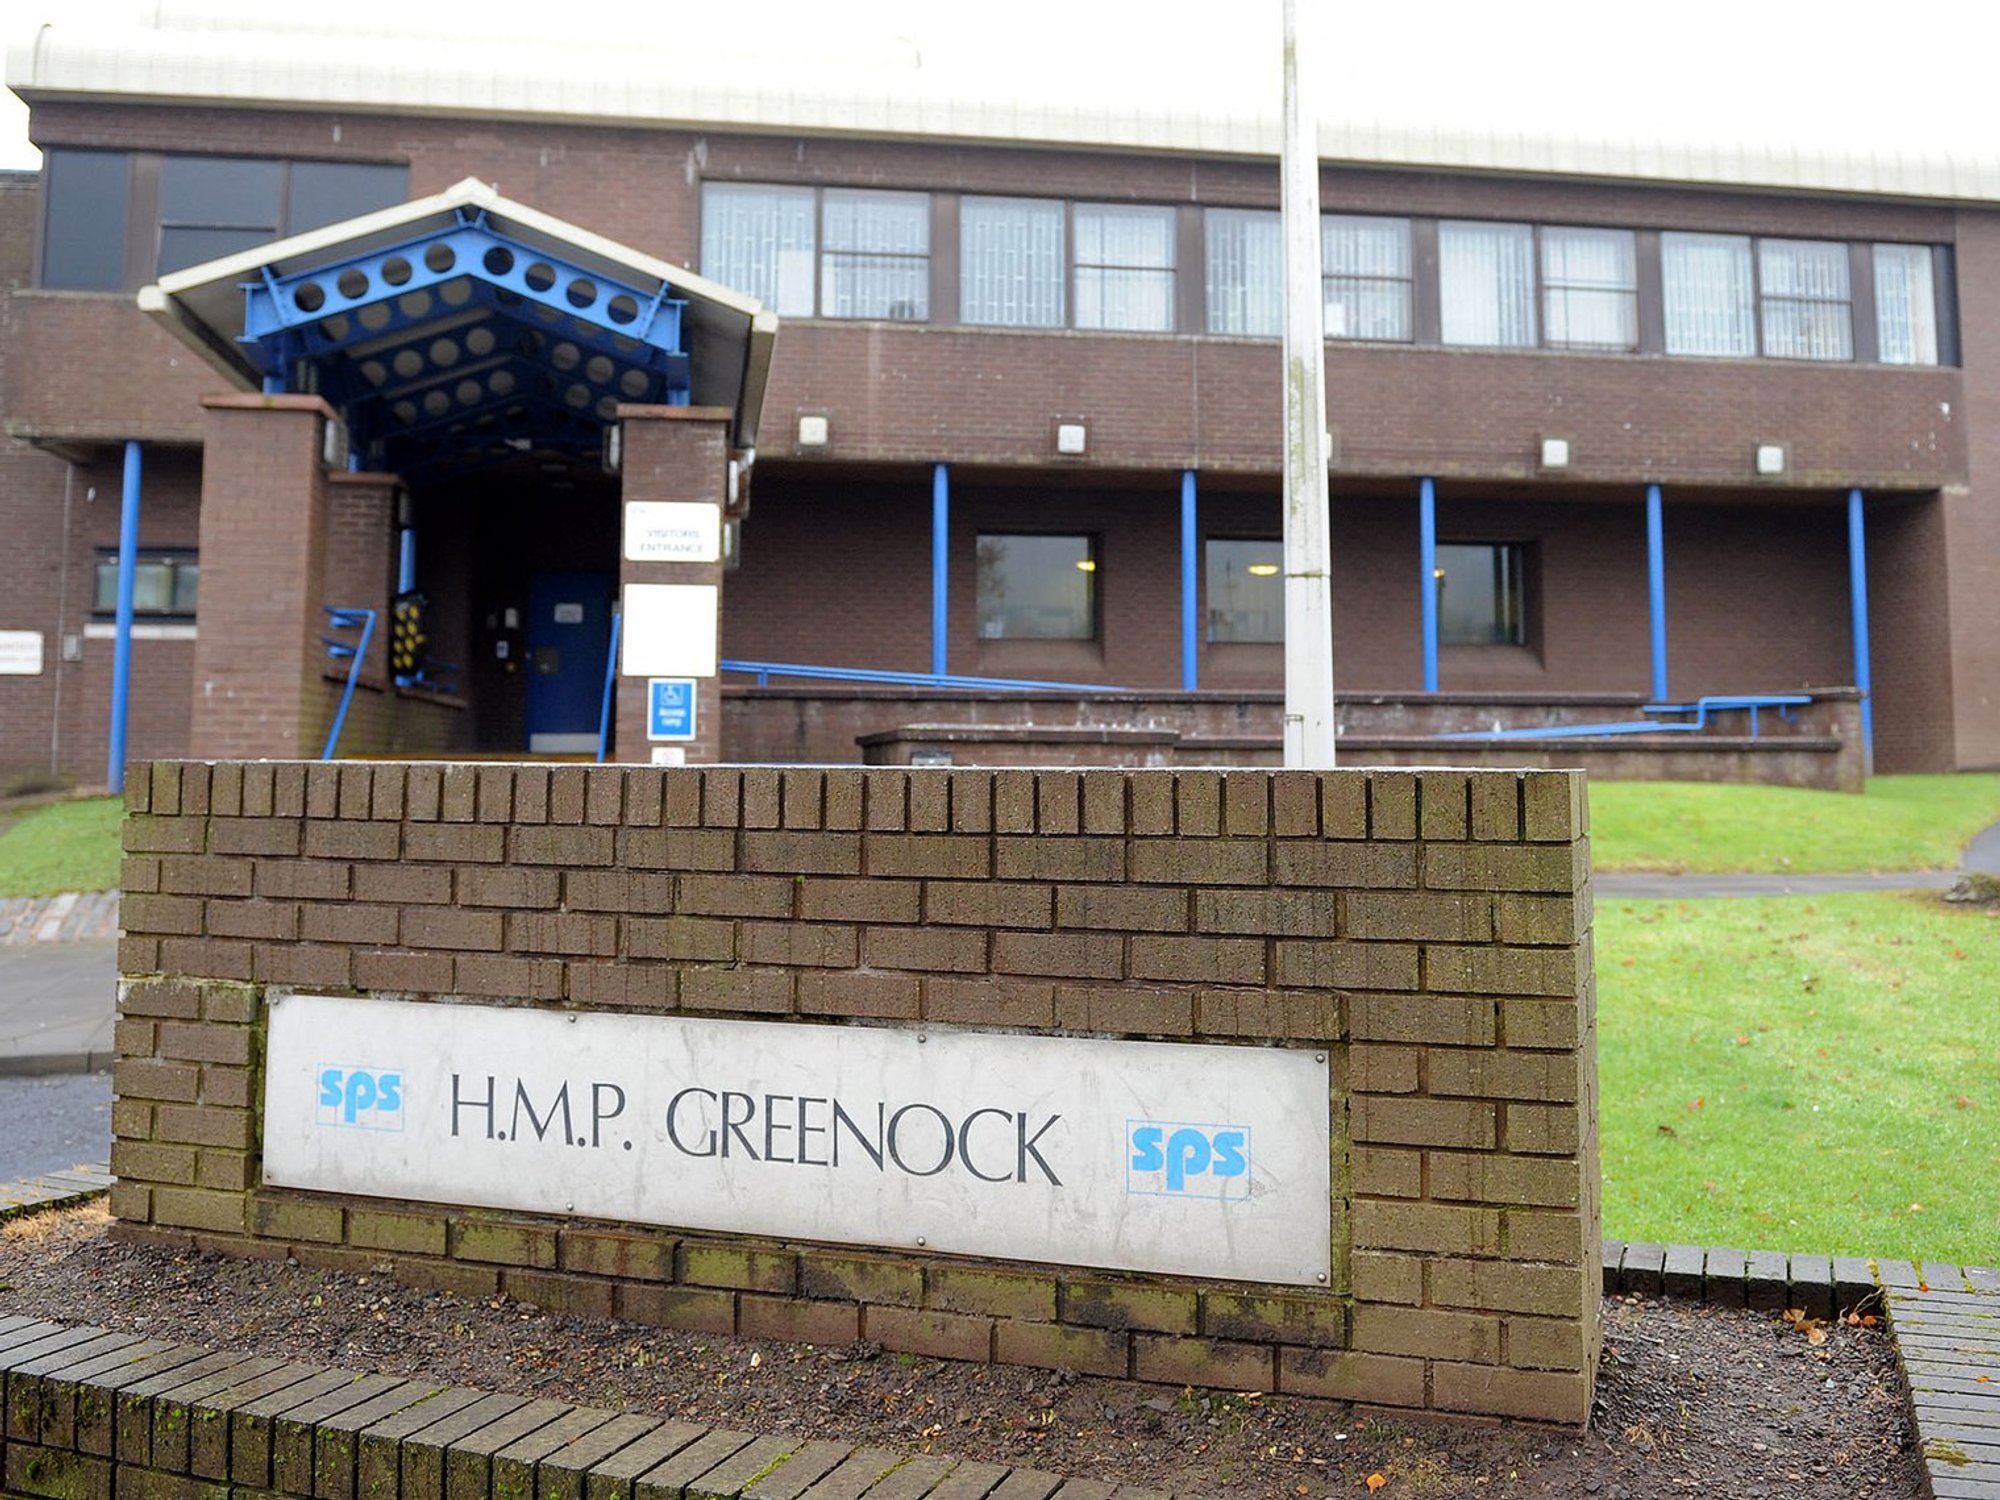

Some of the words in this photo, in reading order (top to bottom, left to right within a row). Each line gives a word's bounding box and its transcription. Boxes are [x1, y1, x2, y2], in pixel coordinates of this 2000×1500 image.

[640, 543, 704, 554] ENTRANCE
[319, 1069, 402, 1123] sps
[451, 1073, 633, 1151] H.M.P.
[666, 1086, 1064, 1187] GREENOCK
[1131, 1126, 1247, 1191] sps
